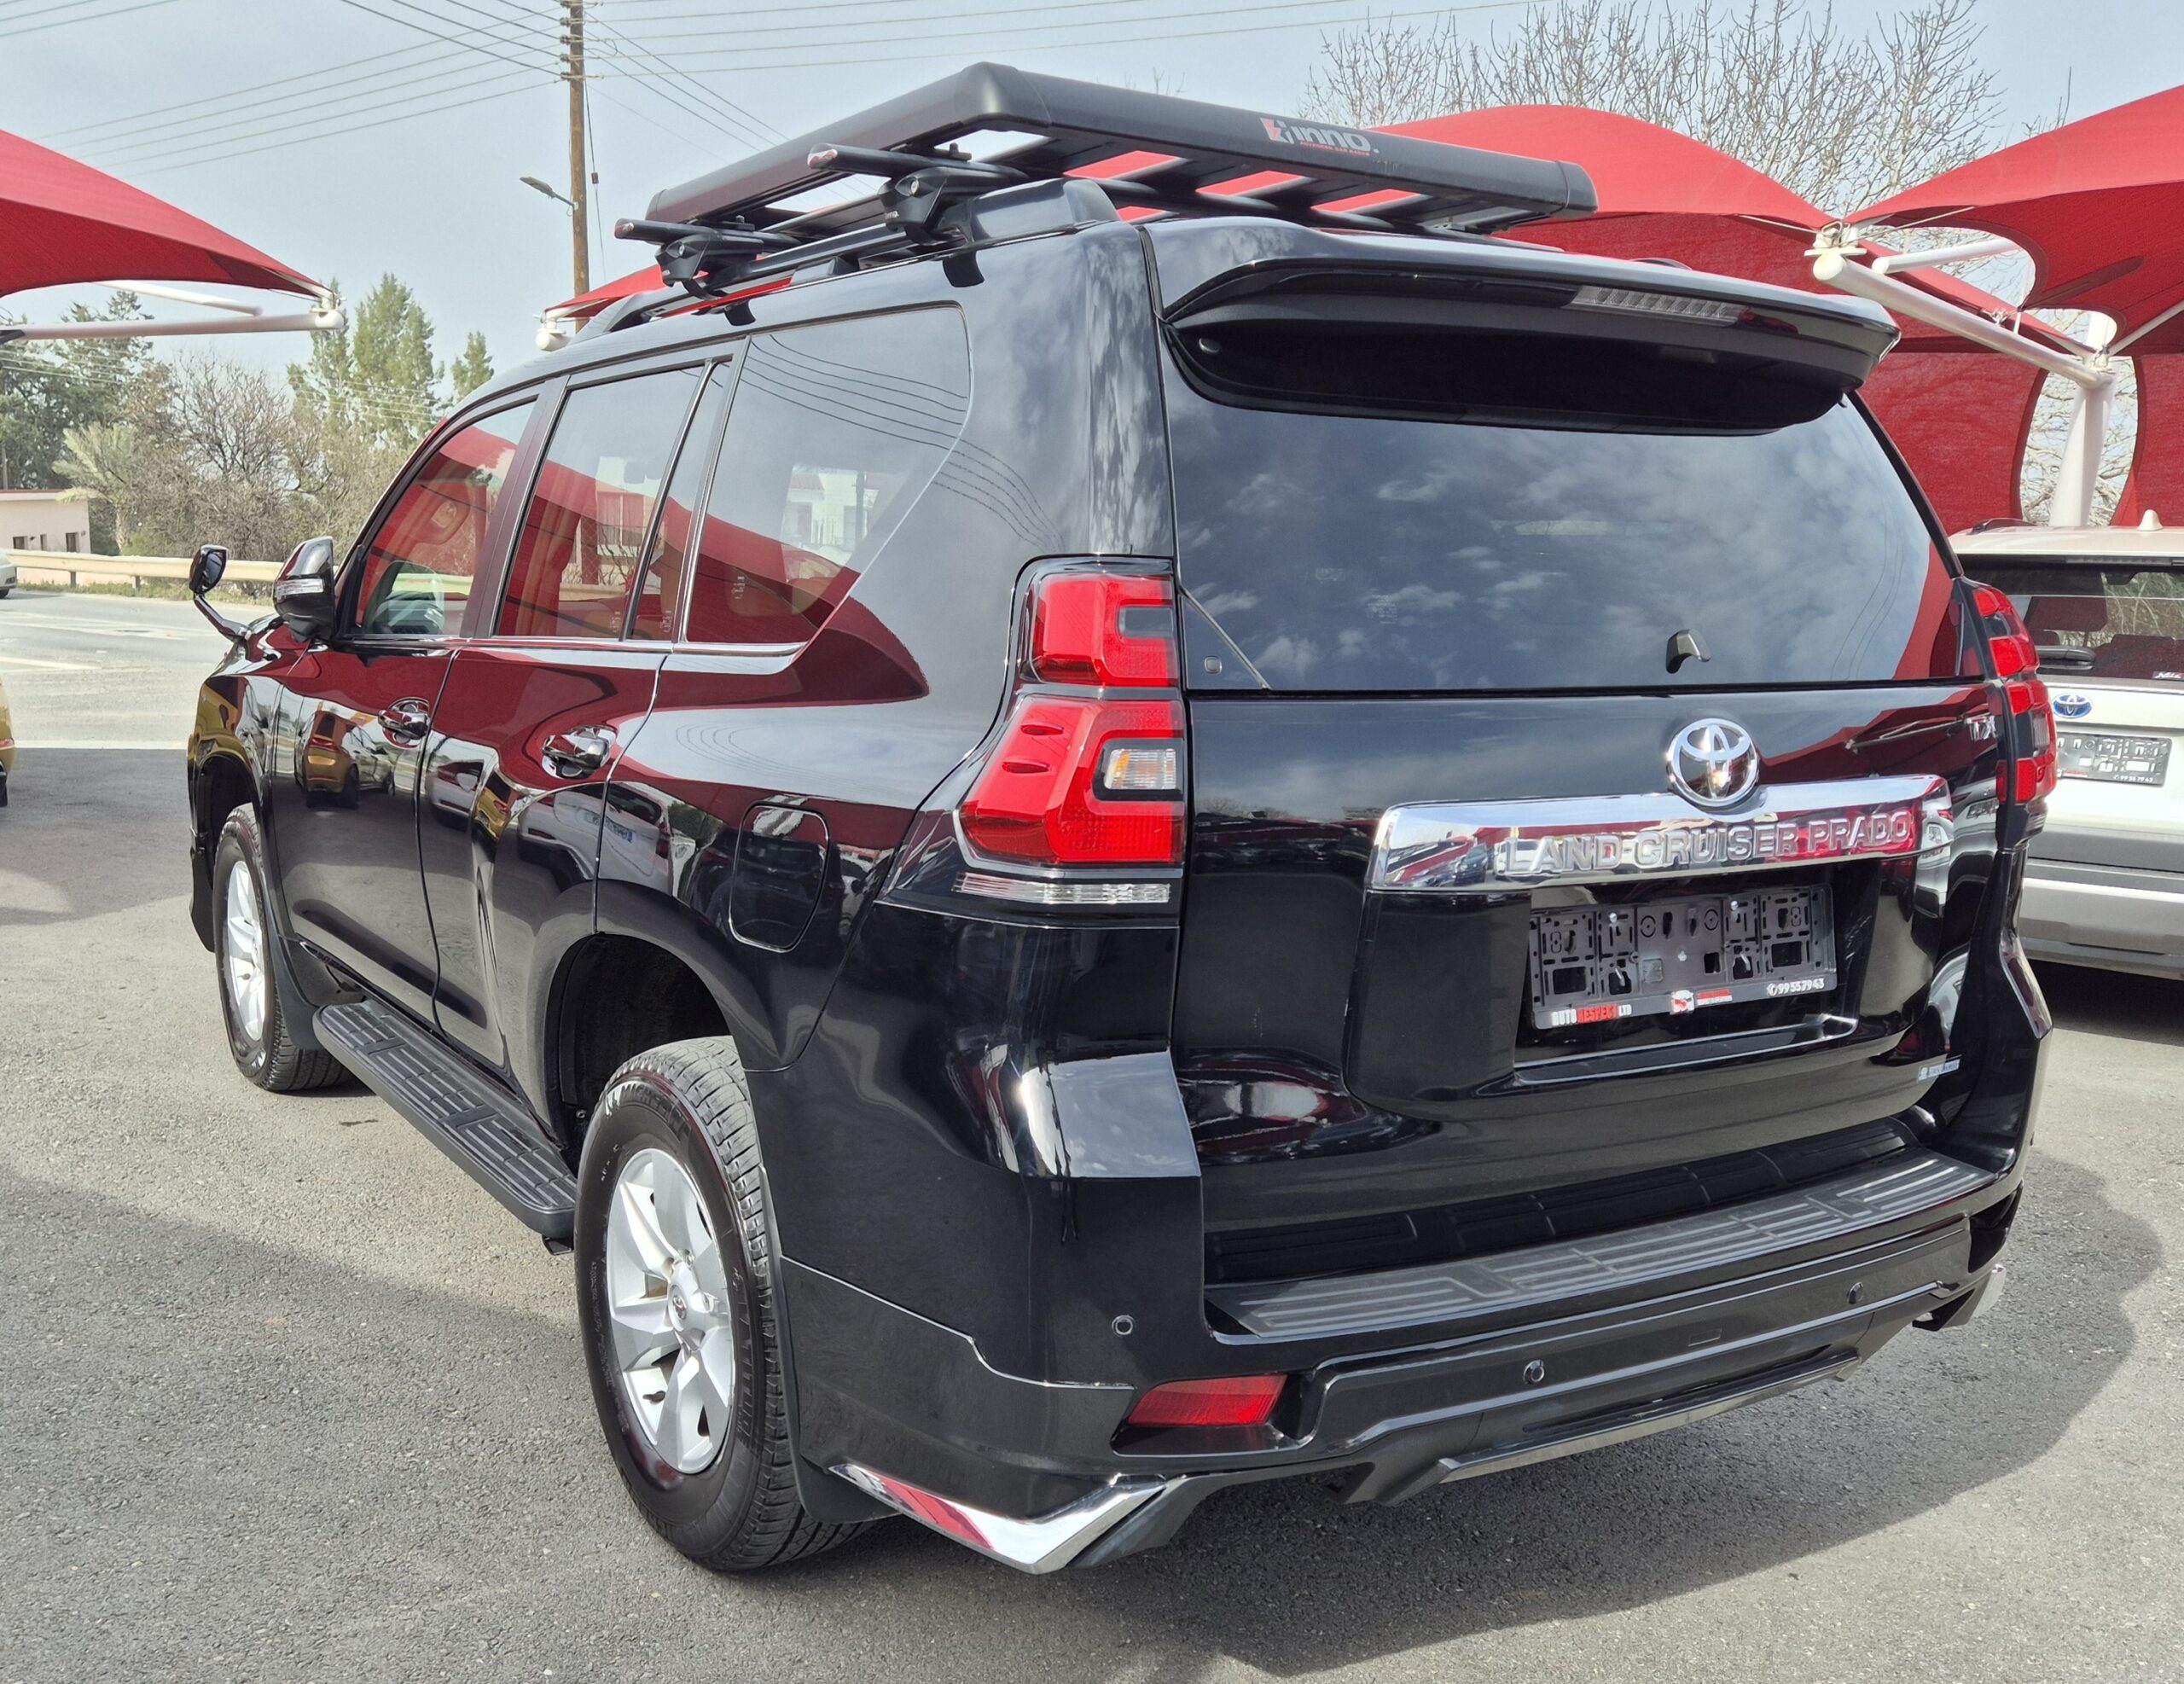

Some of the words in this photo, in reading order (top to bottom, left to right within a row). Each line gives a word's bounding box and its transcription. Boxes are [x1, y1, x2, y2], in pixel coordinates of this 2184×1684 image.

[1504, 833, 1622, 873] LAND
[1634, 823, 1798, 868] CRUISER
[1808, 810, 1912, 852] PRADO
